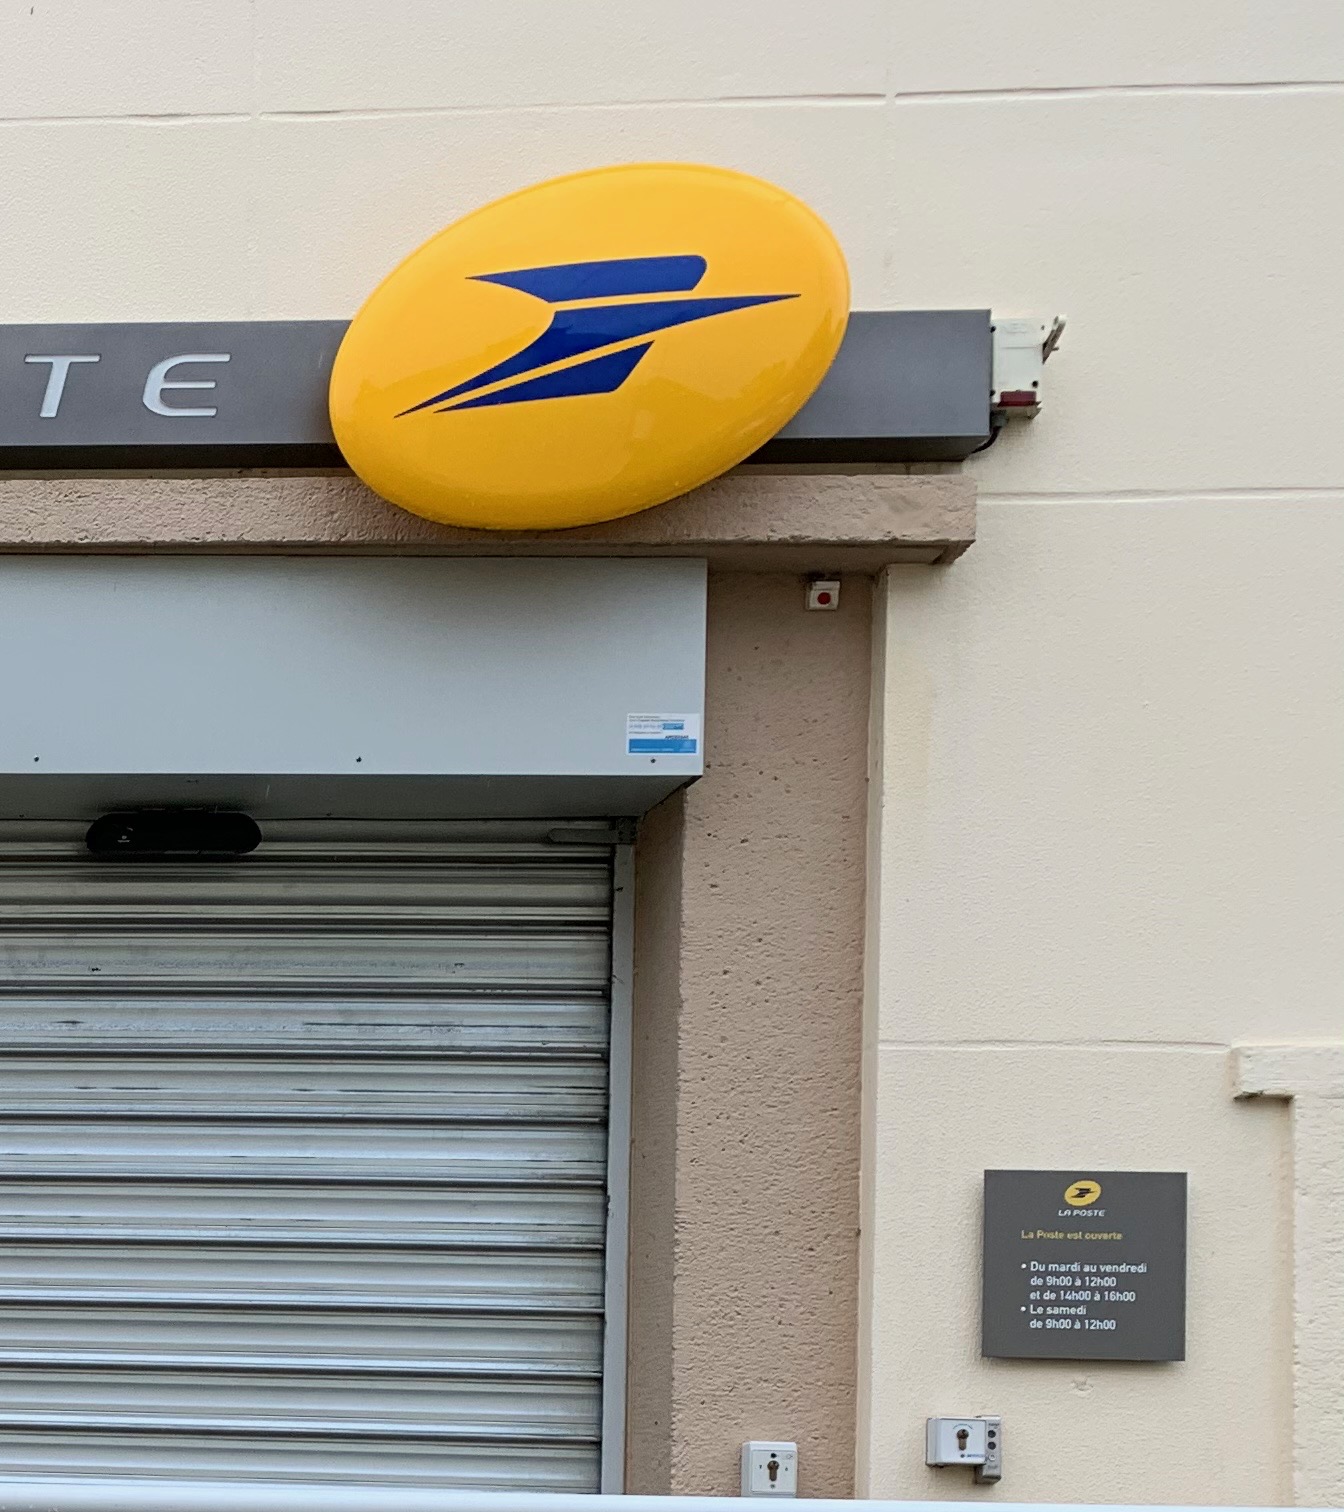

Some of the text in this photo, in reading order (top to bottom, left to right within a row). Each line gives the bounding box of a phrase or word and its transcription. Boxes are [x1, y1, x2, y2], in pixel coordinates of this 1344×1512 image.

[1021, 1230, 1123, 1240] La Poste est ouverte
[1030, 1262, 1148, 1273] Du mardi au vendredi
[1030, 1276, 1116, 1287] de 9h00 à 12h00
[1030, 1290, 1136, 1302] et de 14h00 à 16h00
[1030, 1304, 1087, 1315] Le samedi
[1030, 1318, 1116, 1330] de 9h00 à 12h00
